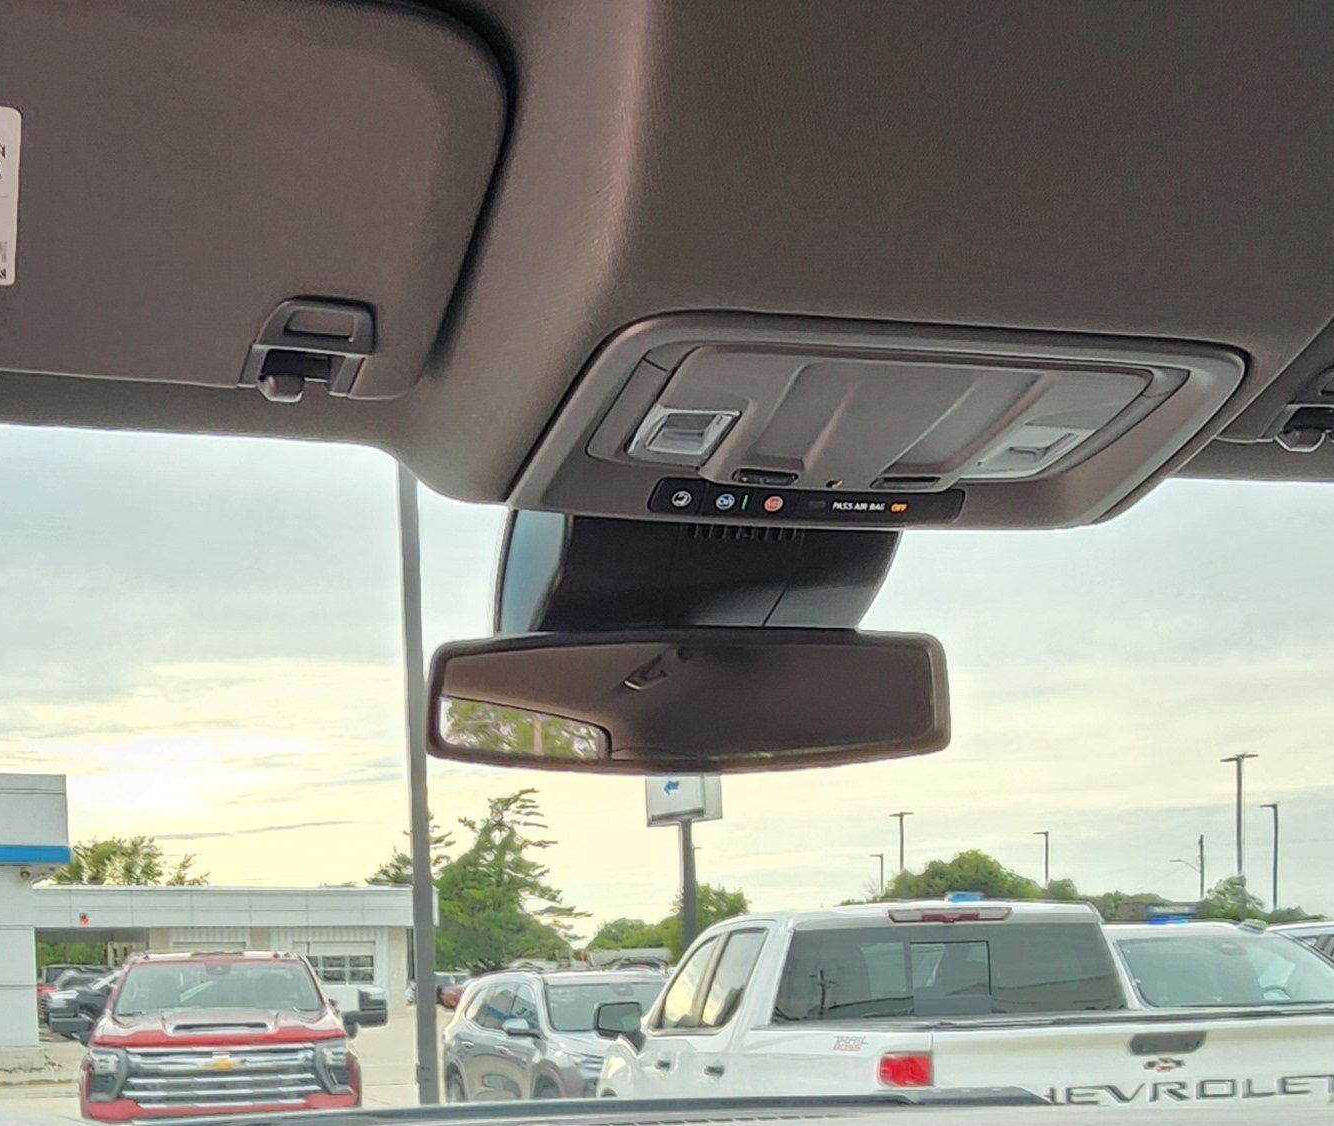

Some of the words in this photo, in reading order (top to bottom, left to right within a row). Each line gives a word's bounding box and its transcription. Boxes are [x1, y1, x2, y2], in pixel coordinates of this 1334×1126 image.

[832, 501, 853, 511] PASS
[854, 502, 868, 511] AIR
[869, 502, 886, 511] BAG
[891, 502, 908, 512] OFF
